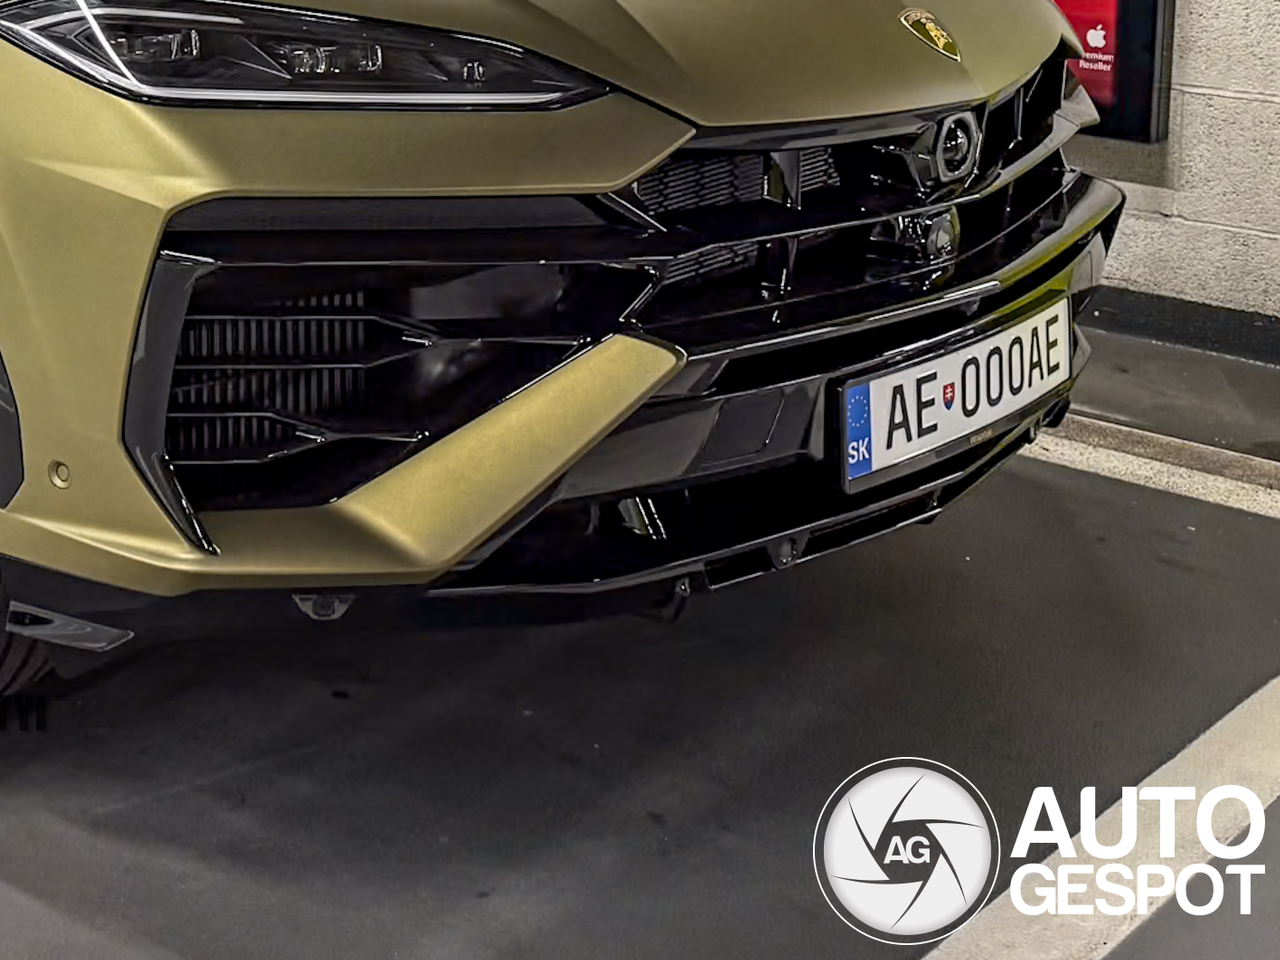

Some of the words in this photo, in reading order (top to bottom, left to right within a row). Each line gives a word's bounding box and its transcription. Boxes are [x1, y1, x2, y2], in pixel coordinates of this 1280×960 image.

[1079, 59, 1112, 71] Reseller
[886, 371, 938, 450] AE
[960, 314, 1061, 418] 000AE
[848, 437, 870, 464] SK
